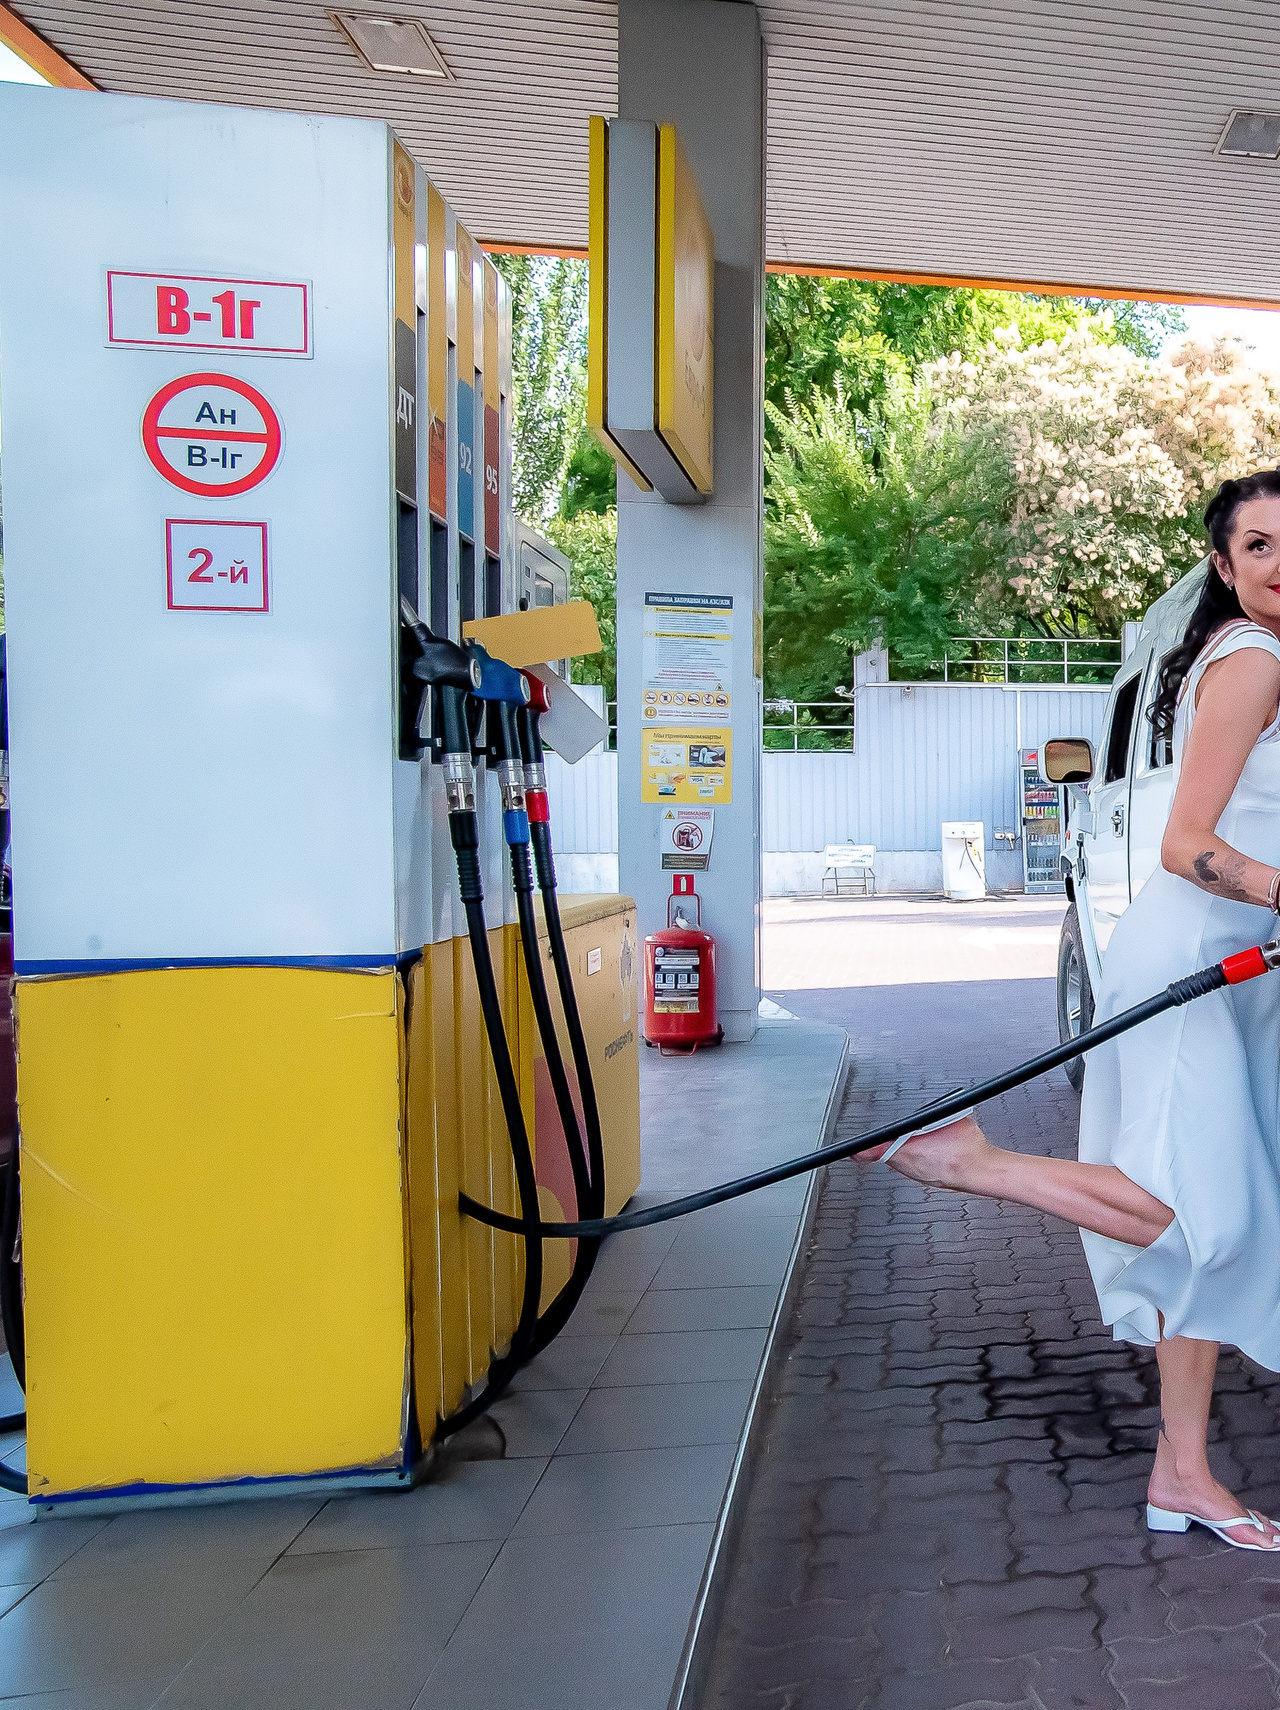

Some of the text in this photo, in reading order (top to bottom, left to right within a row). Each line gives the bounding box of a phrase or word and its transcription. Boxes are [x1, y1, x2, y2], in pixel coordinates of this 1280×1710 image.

[195, 401, 237, 425] Ан
[396, 385, 415, 430] ДТ
[460, 441, 472, 476] 92
[486, 464, 498, 495] 95
[187, 547, 249, 584] 2-й
